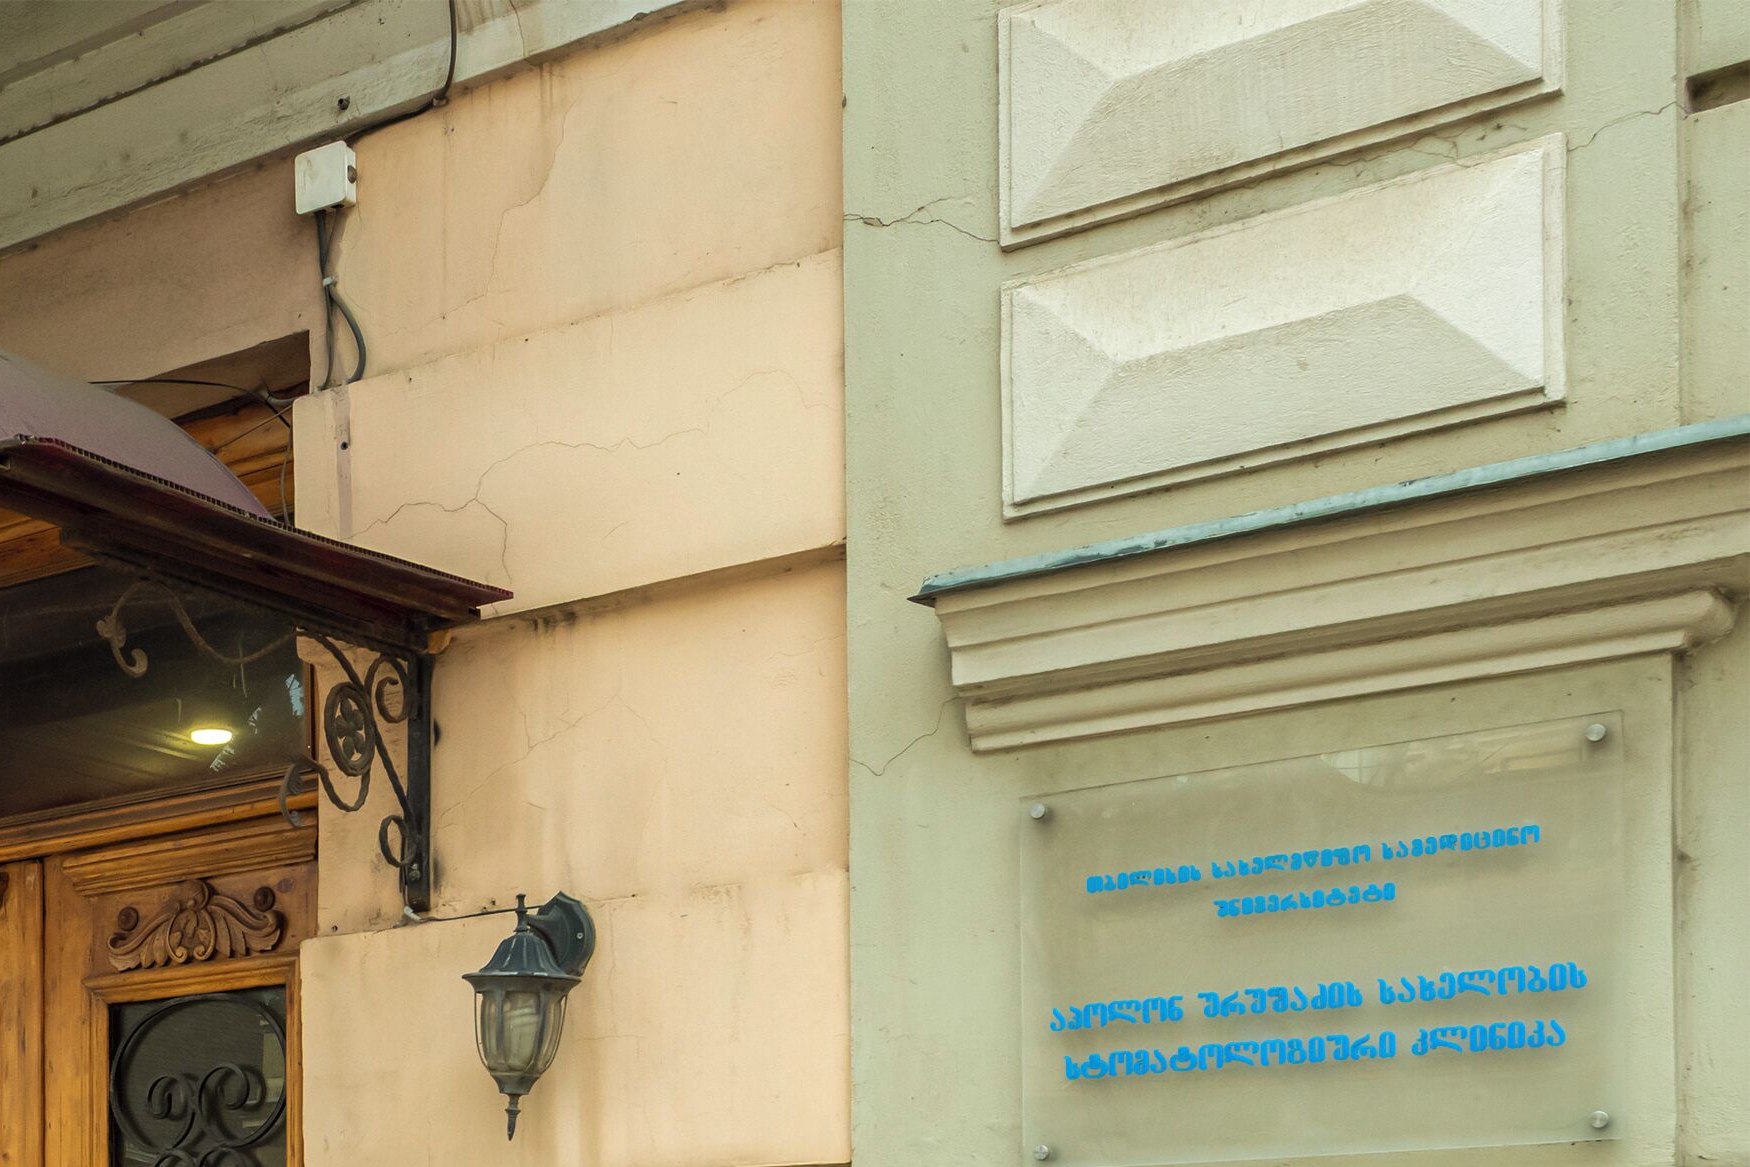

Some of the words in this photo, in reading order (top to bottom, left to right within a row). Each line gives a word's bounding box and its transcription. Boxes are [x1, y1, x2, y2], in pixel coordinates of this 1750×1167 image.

[1086, 864, 1202, 894] თბილისის
[1049, 994, 1185, 1033] აპოლონ
[1196, 980, 1364, 1018] ურუშაძის
[1376, 961, 1588, 1006] სახელობის
[1065, 1031, 1397, 1081] სტომატოლოგიური
[1410, 1018, 1567, 1057] კლინიკა
